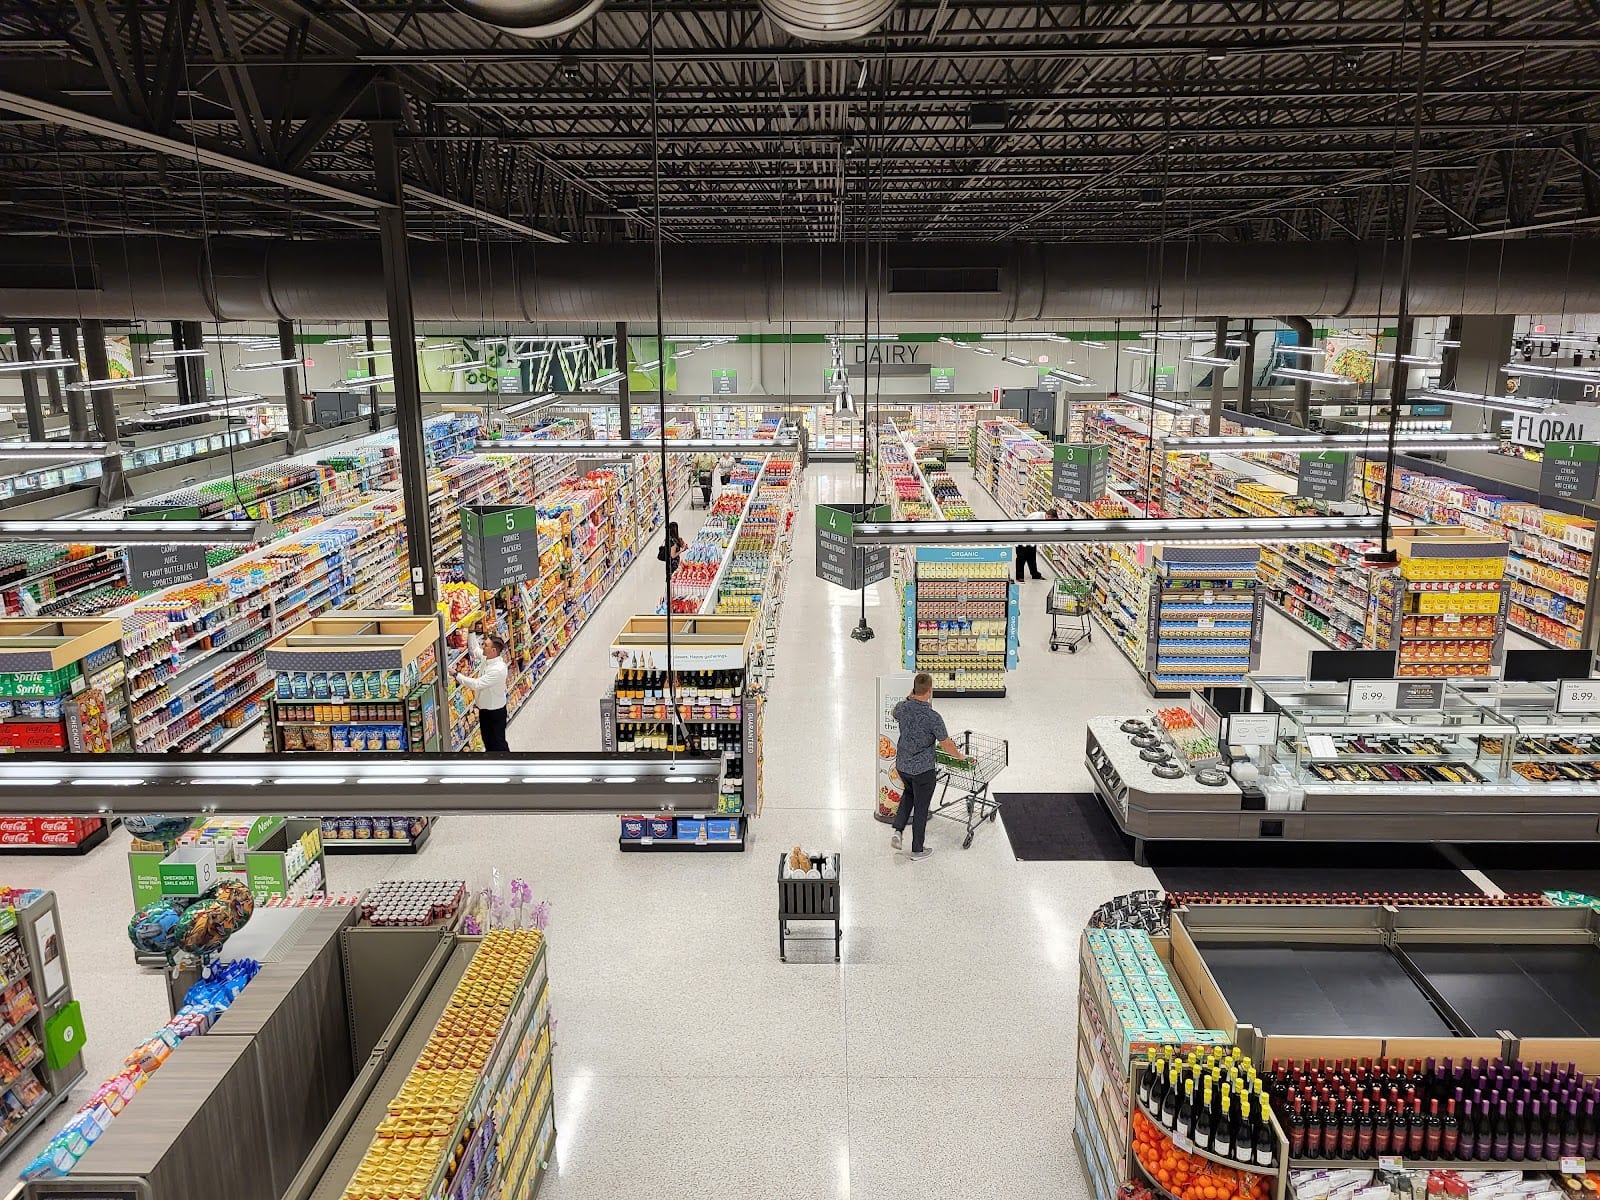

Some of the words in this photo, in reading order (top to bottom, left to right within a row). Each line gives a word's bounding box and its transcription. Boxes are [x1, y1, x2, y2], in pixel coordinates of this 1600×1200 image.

[855, 345, 919, 364] DAIRY
[1517, 415, 1584, 445] FLORAL
[1067, 448, 1074, 461] 3
[1568, 445, 1575, 458] 1
[1554, 475, 1579, 483] COFFEE/TEA
[466, 513, 471, 531] 5
[505, 513, 515, 530] 5
[829, 512, 837, 529] 4
[502, 533, 520, 544] COOKIES
[160, 545, 178, 554] CANDY
[501, 543, 522, 554] CRACKERS
[164, 555, 178, 565] JUICE
[507, 555, 518, 563] NUTS
[142, 568, 164, 579] PEANUT
[164, 561, 200, 576] BUTTER/JELLY
[504, 564, 523, 575] POPCORN
[152, 576, 174, 588] SPORTS
[174, 573, 193, 585] DRINKS
[501, 575, 516, 586] POTATO
[516, 573, 528, 583] CHIPS
[14, 673, 43, 683] Sprite
[16, 684, 45, 696] Sprite
[1361, 692, 1383, 702] 8.99
[1571, 692, 1593, 701] 8.99
[70, 715, 81, 750] CHECKOUT
[885, 723, 897, 731] the
[203, 863, 211, 882] 8
